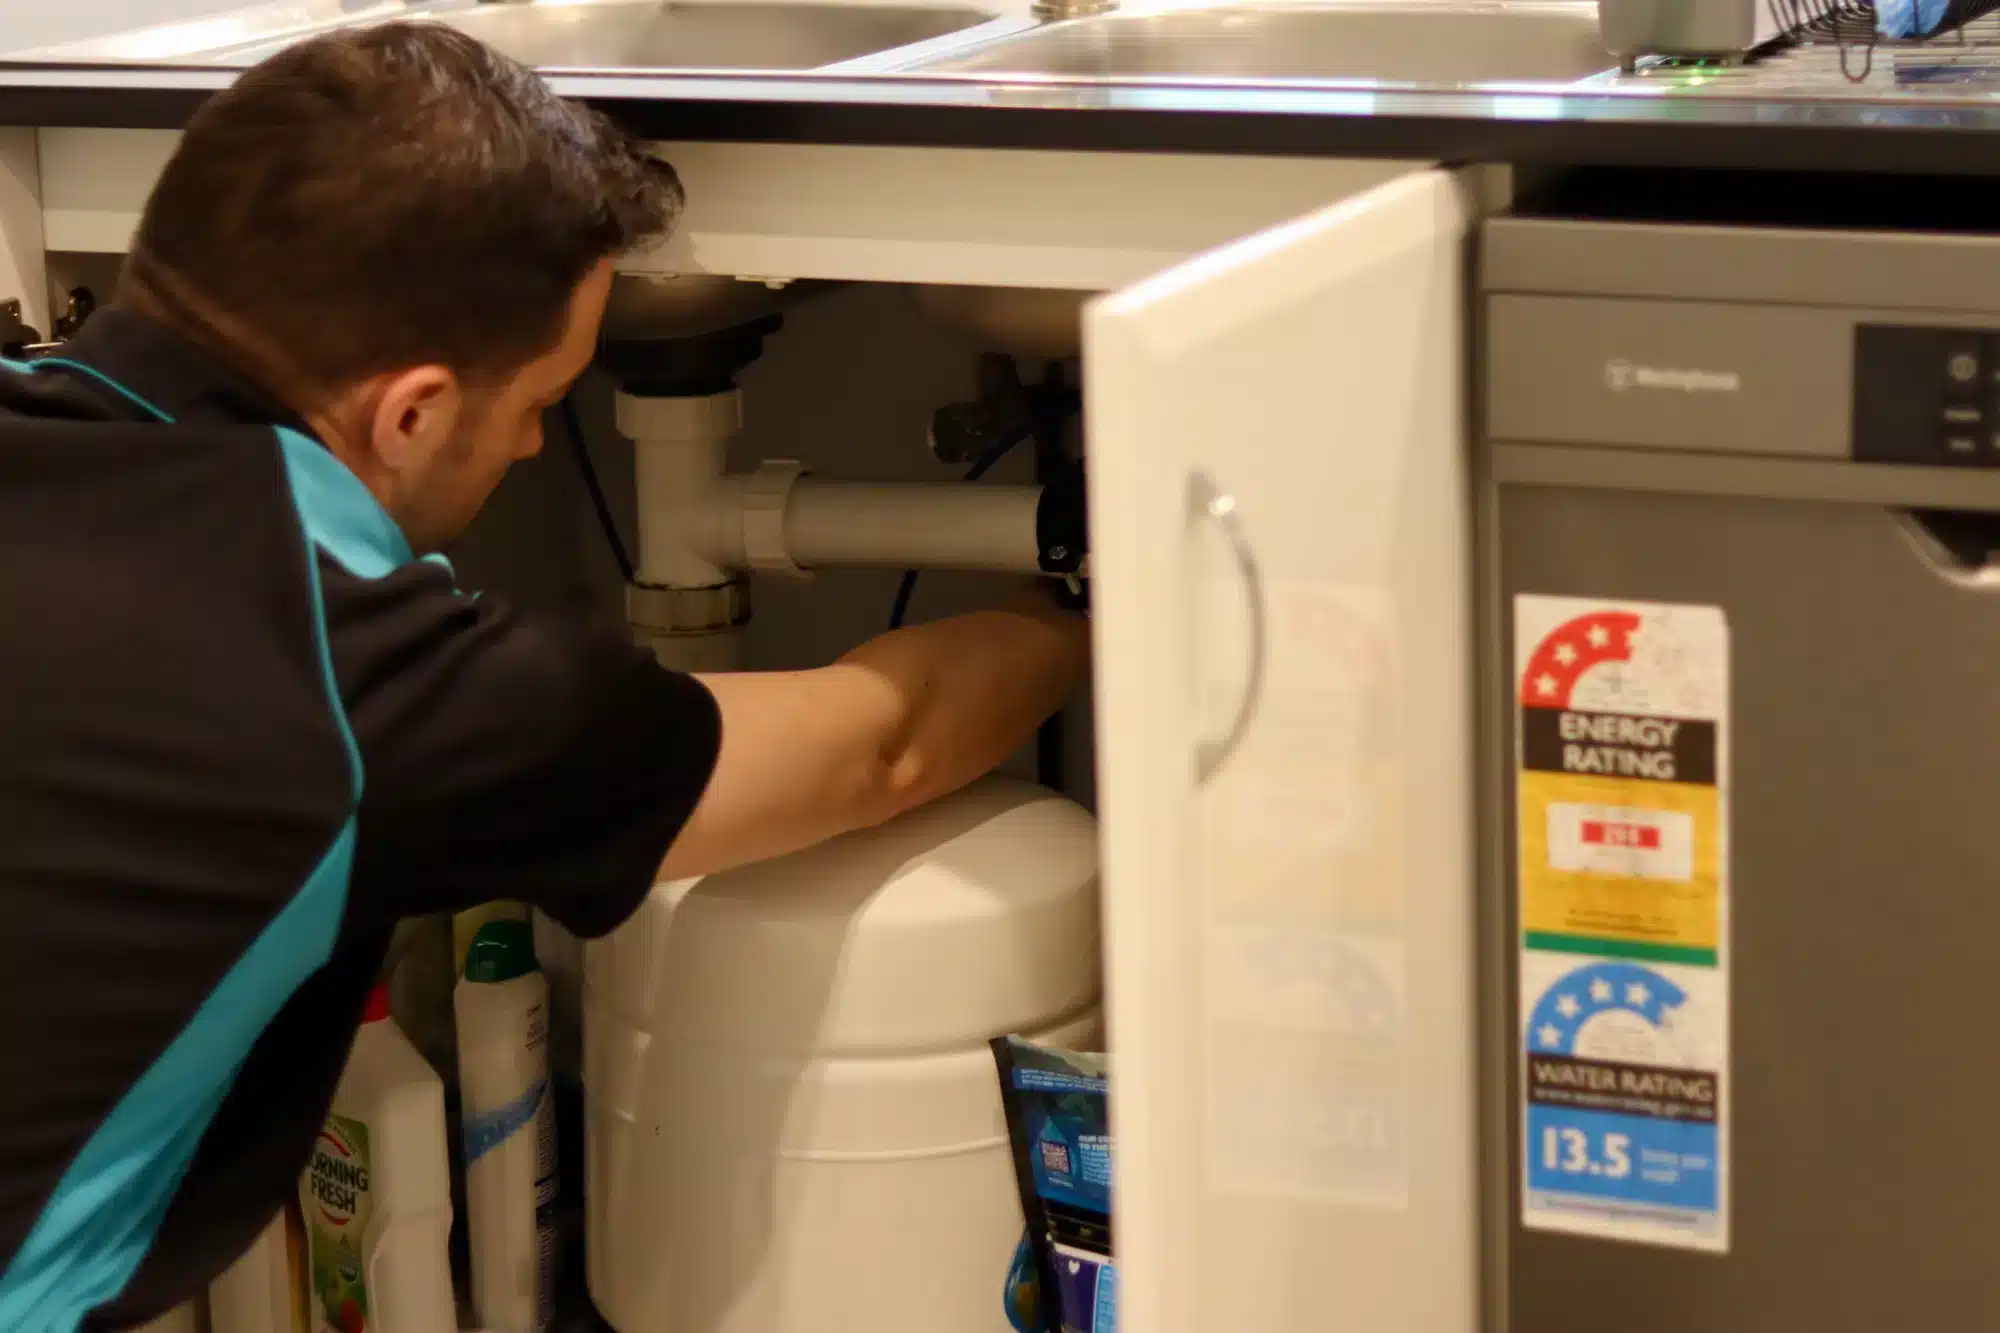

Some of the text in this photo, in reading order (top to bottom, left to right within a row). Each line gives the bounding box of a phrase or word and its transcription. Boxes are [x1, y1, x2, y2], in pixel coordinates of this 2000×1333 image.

[1559, 711, 1679, 748] ENERGY
[1562, 743, 1675, 780] RATING
[1534, 1060, 1616, 1091] WATER
[1620, 1069, 1713, 1102] RATING
[311, 1151, 369, 1192] ORNING
[1543, 1126, 1632, 1179] 13.5
[311, 1173, 356, 1216] FRESH
